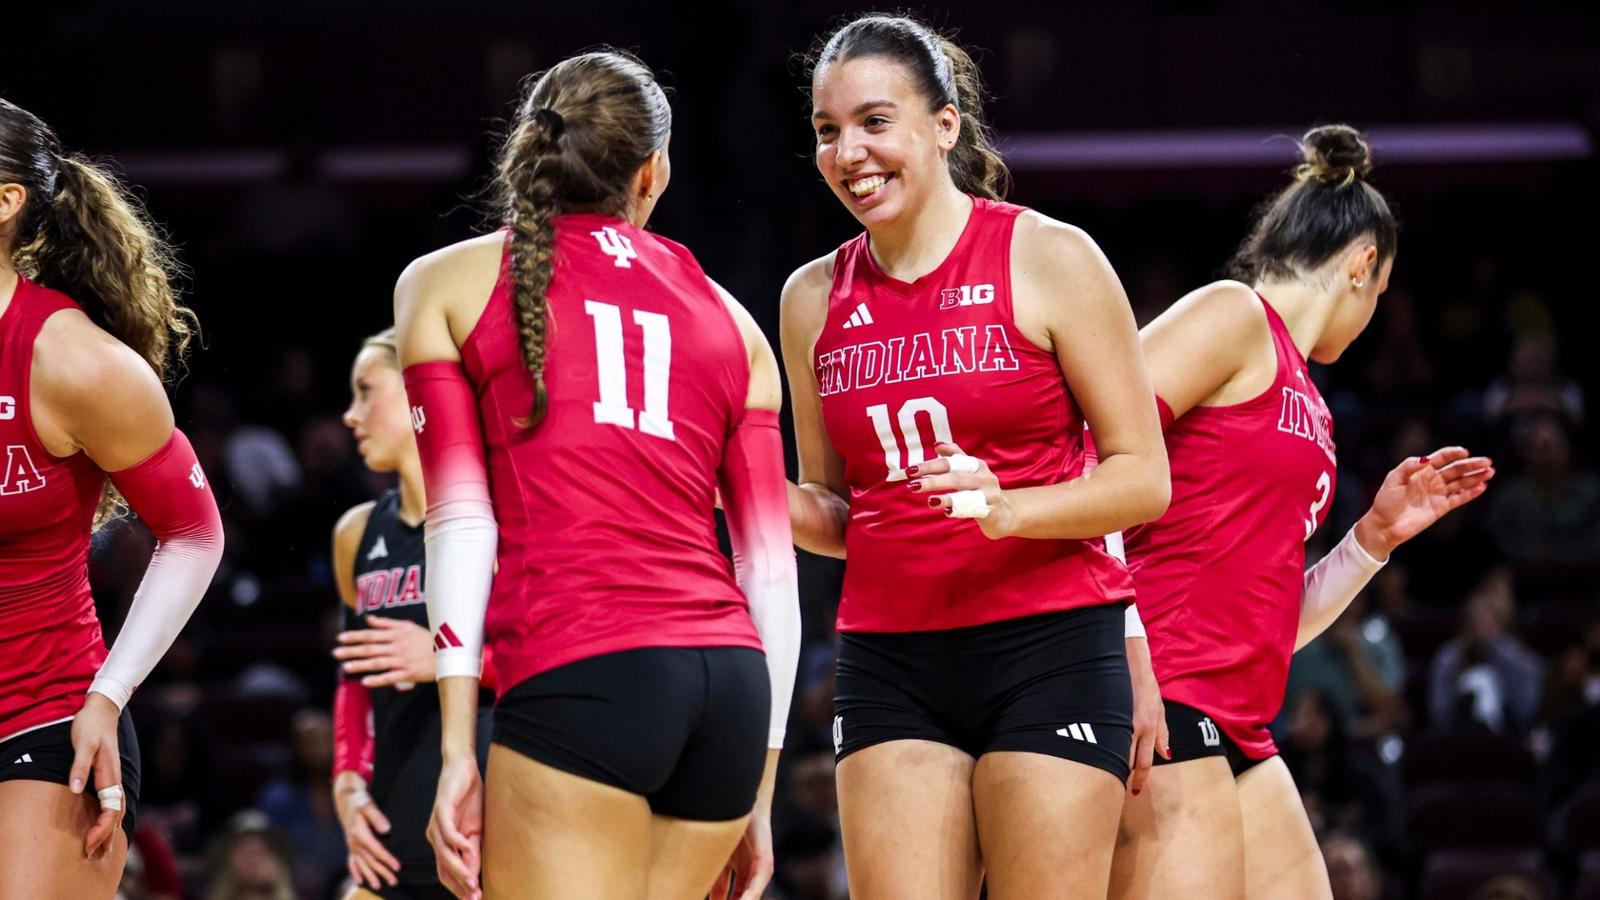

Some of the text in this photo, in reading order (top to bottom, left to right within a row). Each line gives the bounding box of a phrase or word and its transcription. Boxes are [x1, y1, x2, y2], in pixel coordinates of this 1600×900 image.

[584, 299, 676, 442] 11
[817, 324, 1020, 397] INDIANA
[866, 396, 954, 482] 10
